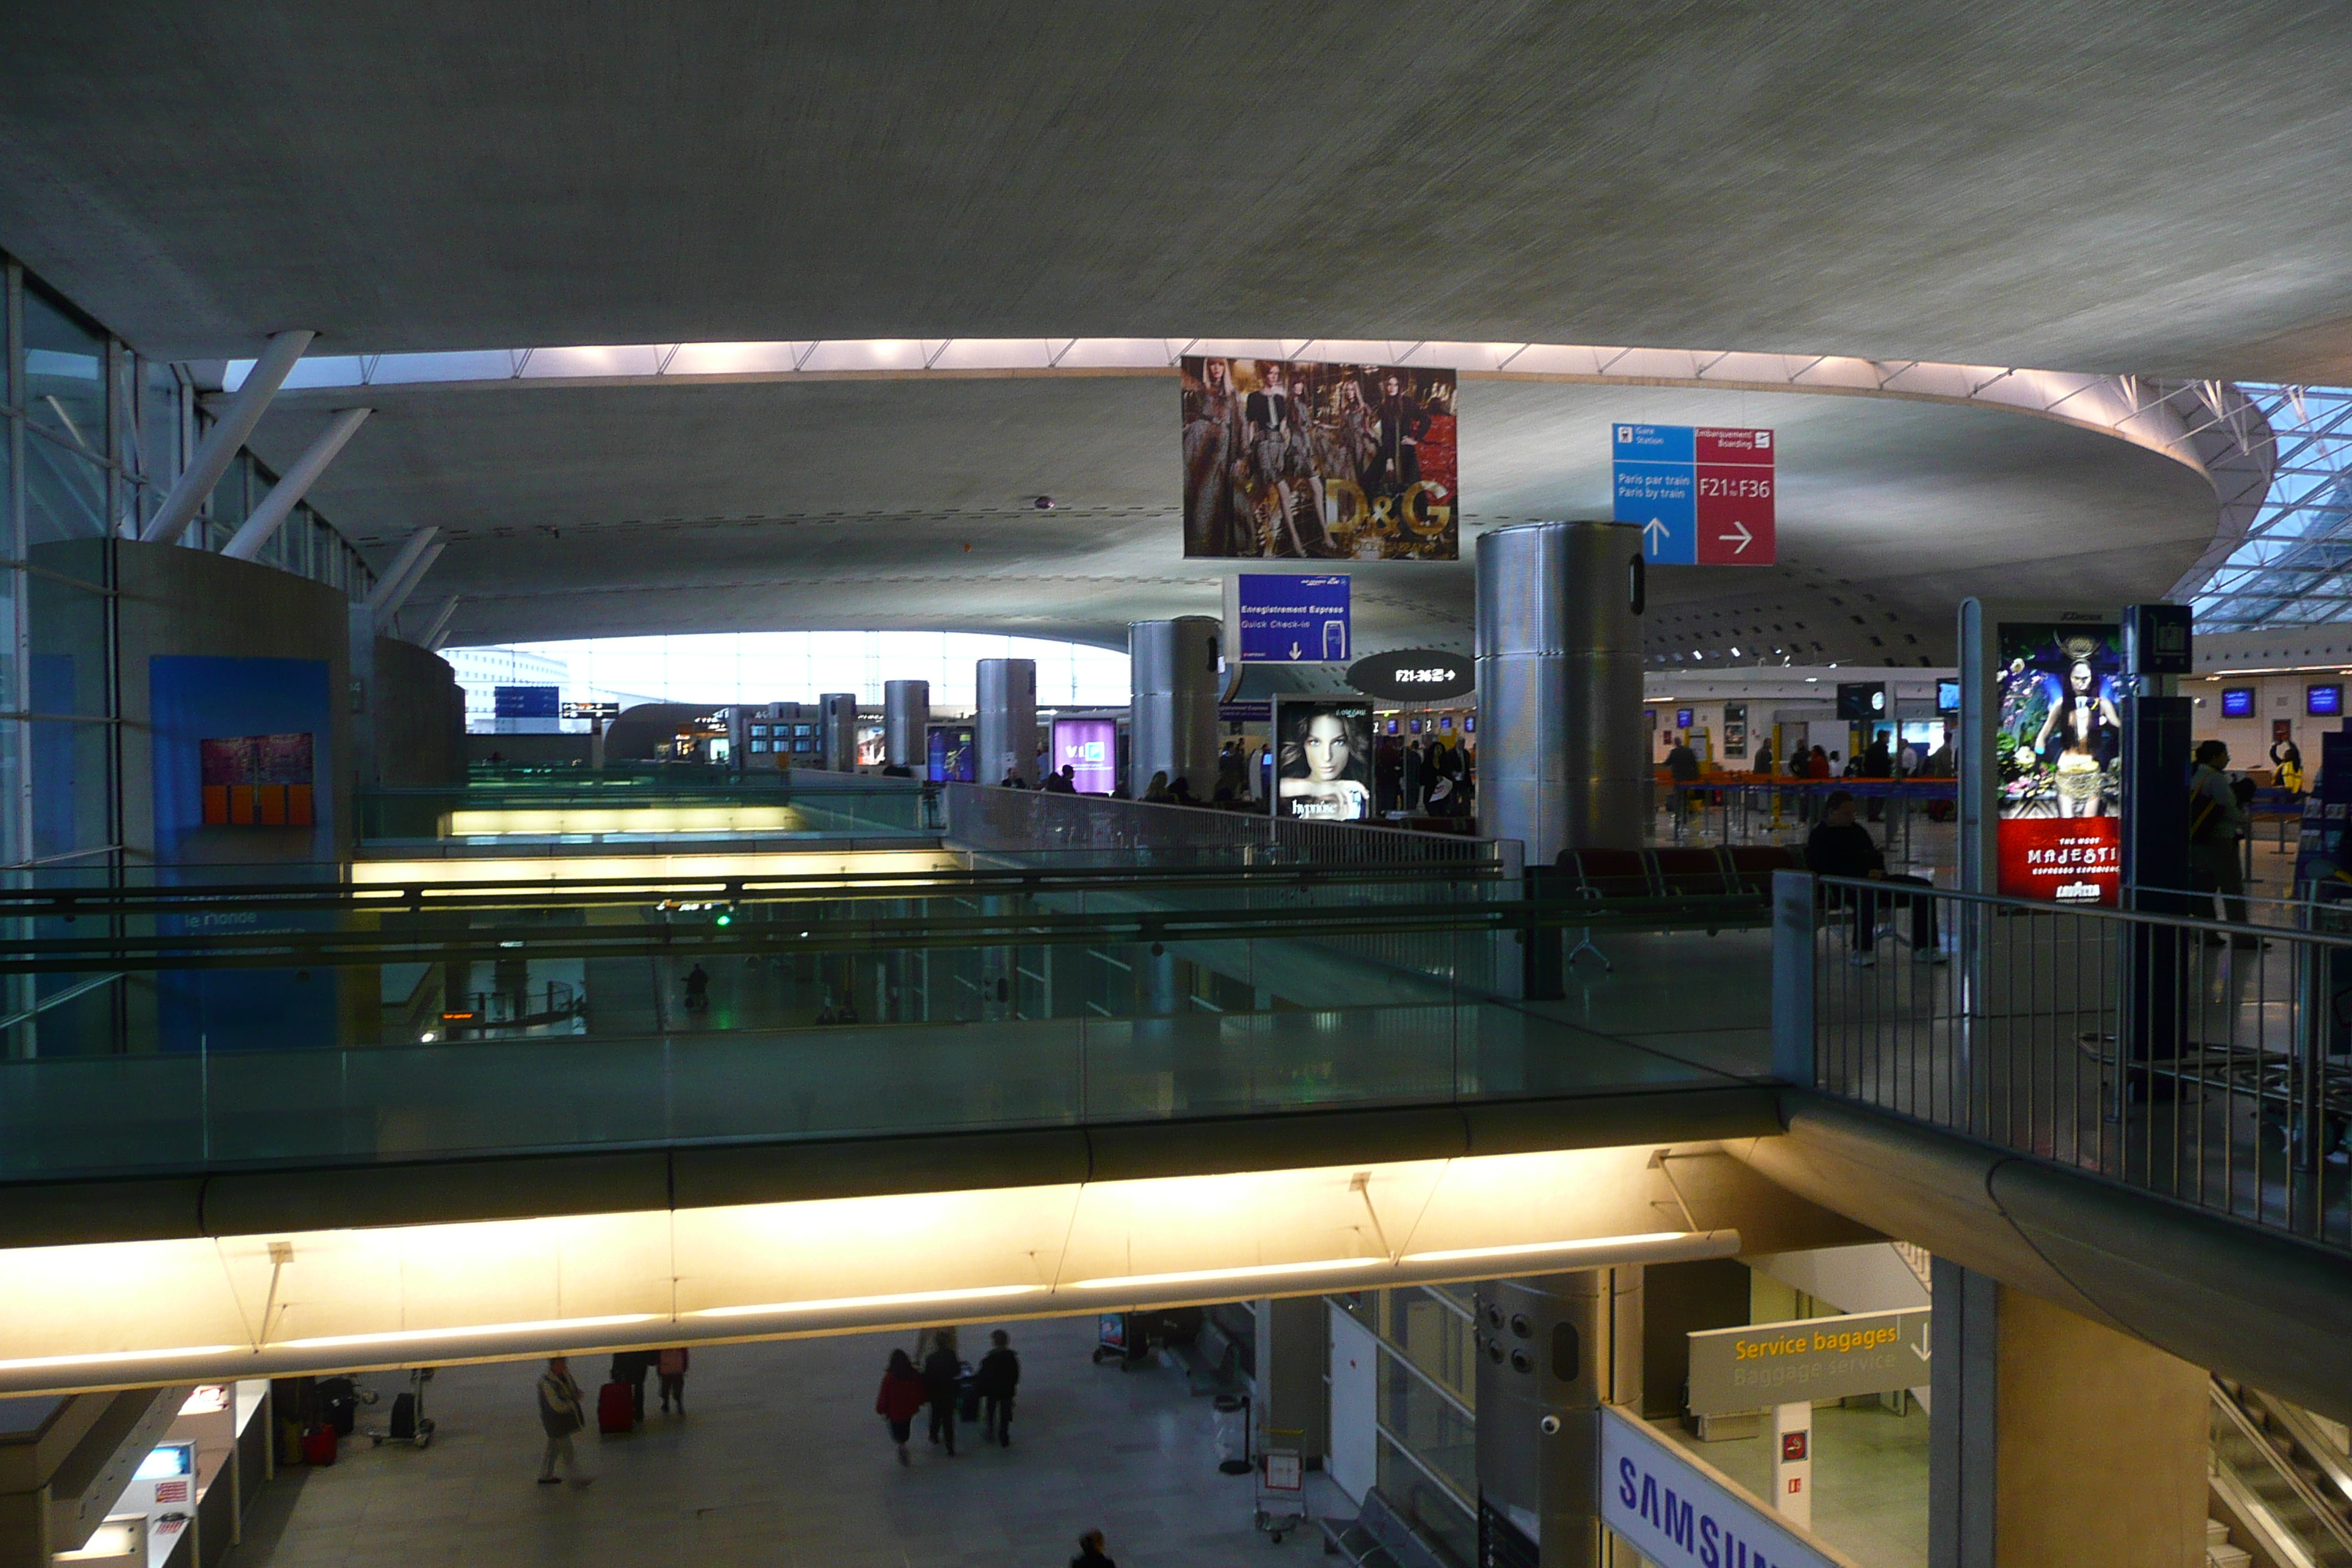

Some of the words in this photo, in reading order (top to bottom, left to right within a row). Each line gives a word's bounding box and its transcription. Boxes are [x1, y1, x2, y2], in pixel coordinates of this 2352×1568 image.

[1636, 436, 1664, 445] Station
[1695, 429, 1752, 440] Embarquement
[1718, 439, 1752, 450] Boarding
[1618, 473, 1643, 484] Paris
[1646, 476, 1663, 486] par
[1665, 475, 1690, 486] train
[1618, 486, 1643, 497] Paris
[1646, 487, 1658, 500] by
[1660, 488, 1686, 499] train
[1700, 478, 1727, 496] F21
[1739, 480, 1771, 498] F36
[1325, 478, 1451, 536] D&G
[1241, 605, 1307, 615] Enregistrement
[1308, 605, 1344, 615] Express
[1241, 620, 1267, 628] Quick
[1270, 619, 1311, 628] Check-in
[1395, 669, 1432, 682] F21-36
[2059, 837, 2076, 845] THE
[2032, 867, 2074, 875] ESPRESSO
[1735, 1335, 1807, 1360] Service
[1814, 1327, 1897, 1352] bagages
[1734, 1362, 1820, 1387] Baggage
[1619, 1456, 1780, 1568] SAMSU
